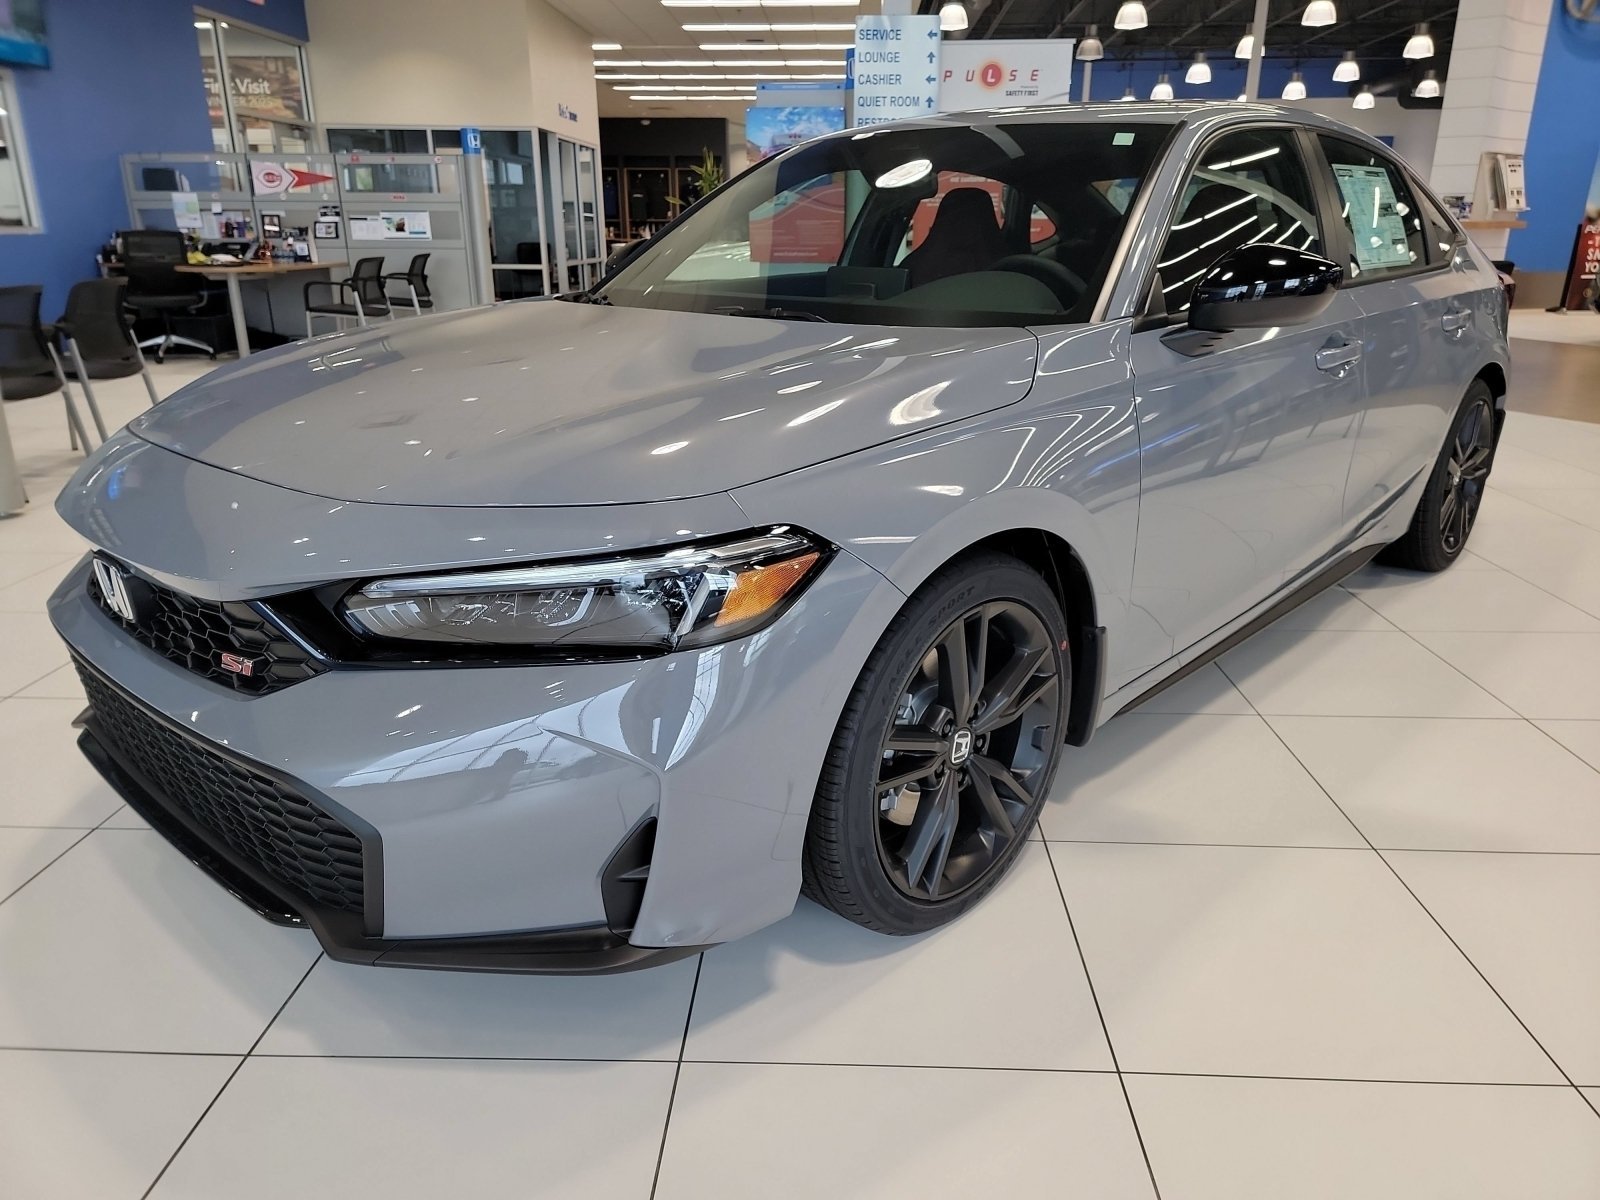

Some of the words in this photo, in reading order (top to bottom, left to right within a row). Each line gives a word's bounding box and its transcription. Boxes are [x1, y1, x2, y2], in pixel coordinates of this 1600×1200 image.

[858, 29, 902, 41] SERVICE
[858, 51, 900, 63] LOUNGE
[857, 74, 902, 86] CASHIER
[943, 69, 1039, 83] PULSE
[203, 77, 236, 95] Fir
[235, 78, 271, 95] Visit
[857, 96, 888, 108] QUIET
[889, 96, 920, 107] ROOM
[928, 585, 975, 627] SPORT
[221, 653, 253, 676] Si
